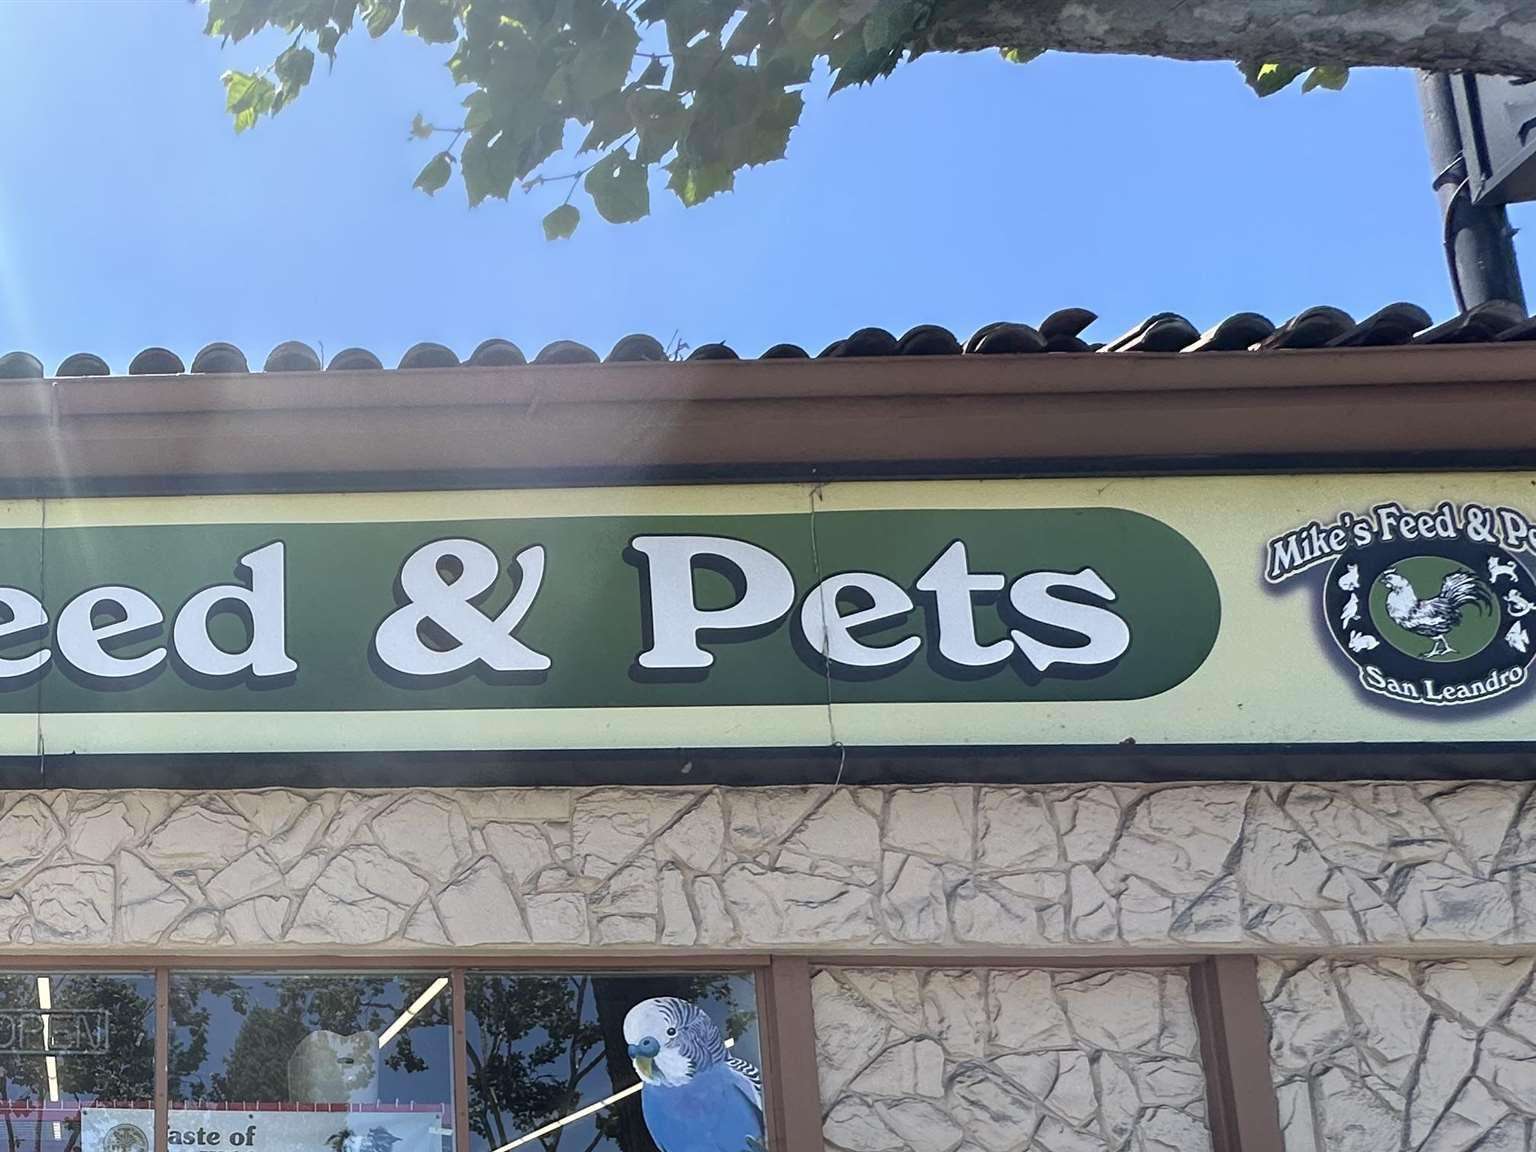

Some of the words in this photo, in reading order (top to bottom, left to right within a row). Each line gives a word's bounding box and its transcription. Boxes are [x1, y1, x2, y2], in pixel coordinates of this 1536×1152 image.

[1271, 515, 1373, 577] Mike's
[1377, 505, 1457, 542] Feed
[1466, 505, 1497, 543] &
[375, 538, 552, 675] &
[631, 535, 1131, 672] Pets
[1365, 665, 1418, 697] San
[1423, 665, 1524, 701] Leandro
[167, 1125, 220, 1146] aste
[229, 1125, 257, 1147] of
